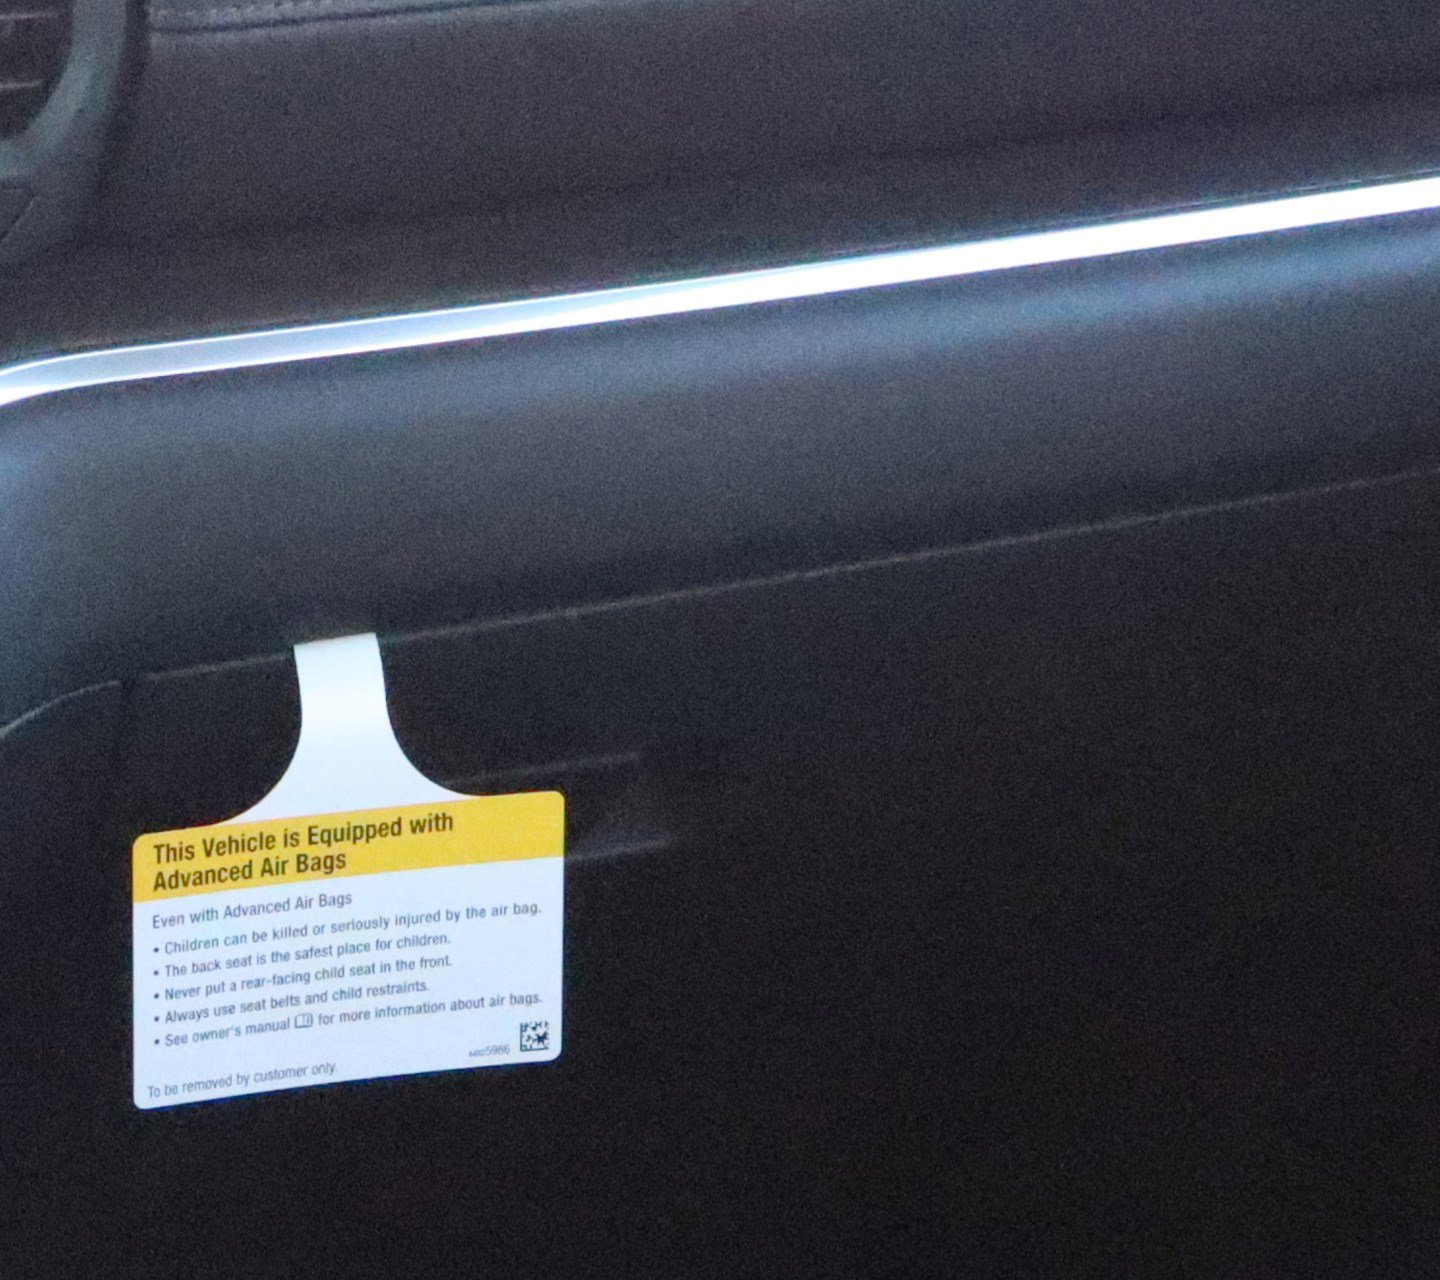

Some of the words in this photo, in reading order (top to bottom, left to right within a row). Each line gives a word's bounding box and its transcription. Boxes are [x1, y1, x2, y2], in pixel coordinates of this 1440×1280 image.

[153, 841, 195, 864] This
[203, 832, 276, 857] Vehicle
[283, 829, 300, 847] is
[308, 816, 402, 847] Equipped
[410, 812, 453, 834] with
[153, 860, 253, 891] Advanced
[261, 857, 288, 877] Air
[296, 853, 346, 874] Bags
[153, 914, 184, 929] Even
[190, 908, 218, 924] with
[223, 898, 290, 919] Advanced
[295, 896, 314, 910] Air
[319, 893, 352, 908] Bags
[165, 935, 219, 954] Children
[224, 933, 247, 946] can
[252, 930, 268, 942] be
[273, 924, 307, 940] killed
[313, 924, 325, 935] or
[331, 916, 390, 933] seriously
[395, 910, 441, 928] injured
[445, 909, 460, 923] by
[466, 907, 486, 919] the
[491, 904, 508, 916] air
[513, 903, 541, 915] bag.
[165, 965, 187, 977] The
[192, 960, 220, 974] back
[225, 955, 252, 969] seat
[257, 954, 266, 965] is
[271, 951, 290, 963] the
[295, 945, 332, 960] safest
[337, 943, 370, 957] place
[375, 939, 392, 950] for
[396, 934, 451, 949] children.
[165, 986, 201, 1000] Never
[205, 982, 225, 997] put
[229, 982, 237, 992] a
[241, 972, 310, 989] rear-facing
[314, 966, 345, 980] child
[349, 963, 376, 977] seat
[380, 961, 391, 972] in
[396, 959, 415, 971] the
[165, 1008, 209, 1023] Always
[213, 1004, 235, 1016] use
[240, 999, 266, 1013] seat
[271, 994, 301, 1008] belts
[305, 990, 327, 1004] and
[332, 987, 362, 1001] child
[366, 980, 429, 997] restraints.
[165, 1034, 188, 1046] See
[192, 1026, 241, 1042] owner's
[245, 1018, 290, 1035] manual
[318, 1014, 334, 1025] for
[339, 1008, 370, 1021] more
[375, 1002, 446, 1018] information
[450, 997, 484, 1011] about
[489, 995, 505, 1007] air
[509, 993, 542, 1006] bags.
[148, 1086, 160, 1098] To
[165, 1083, 178, 1095] be
[182, 1074, 232, 1093] removed
[236, 1071, 250, 1086] by
[253, 1066, 307, 1083] customer
